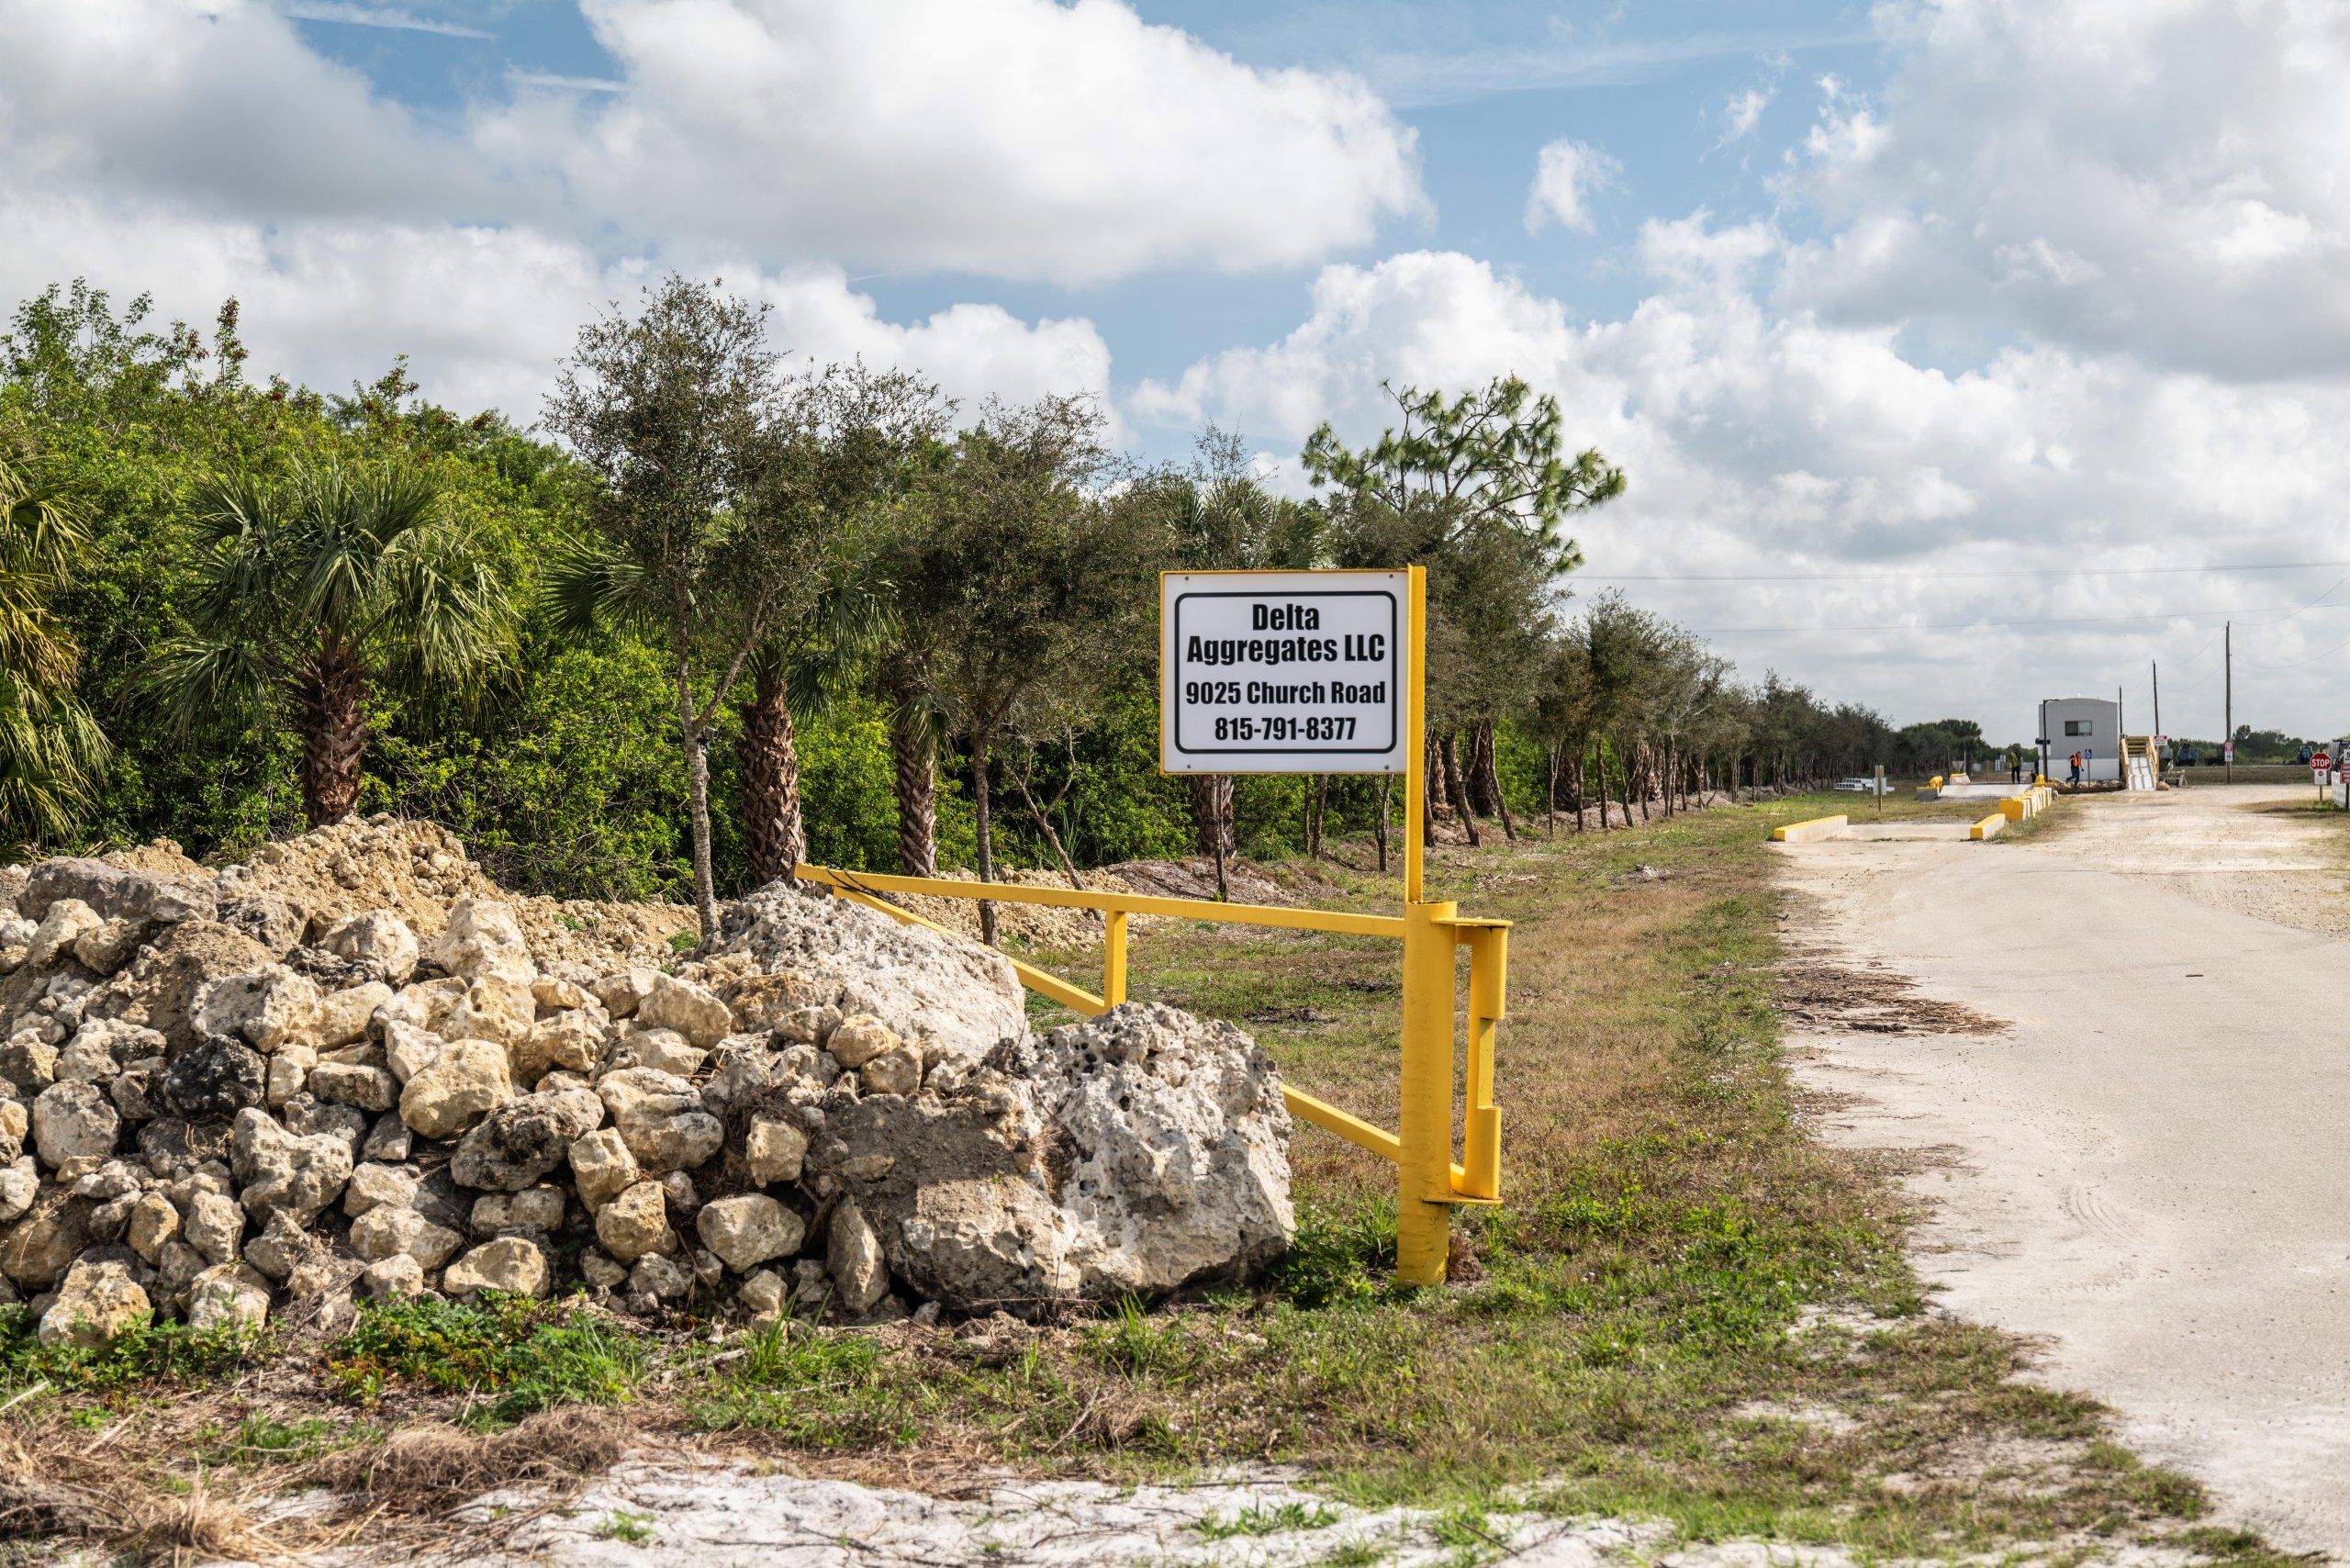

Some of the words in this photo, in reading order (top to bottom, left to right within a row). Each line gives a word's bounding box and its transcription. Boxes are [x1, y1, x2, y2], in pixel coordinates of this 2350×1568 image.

[1252, 604, 1319, 631] Delta
[1187, 635, 1337, 666] Aggregates
[1345, 634, 1384, 661] LLC
[1186, 682, 1241, 704] 9025
[1247, 681, 1325, 704] Church
[1331, 681, 1385, 703] Road
[1214, 717, 1357, 741] 815-791-8377
[2311, 758, 2330, 767] STOP
